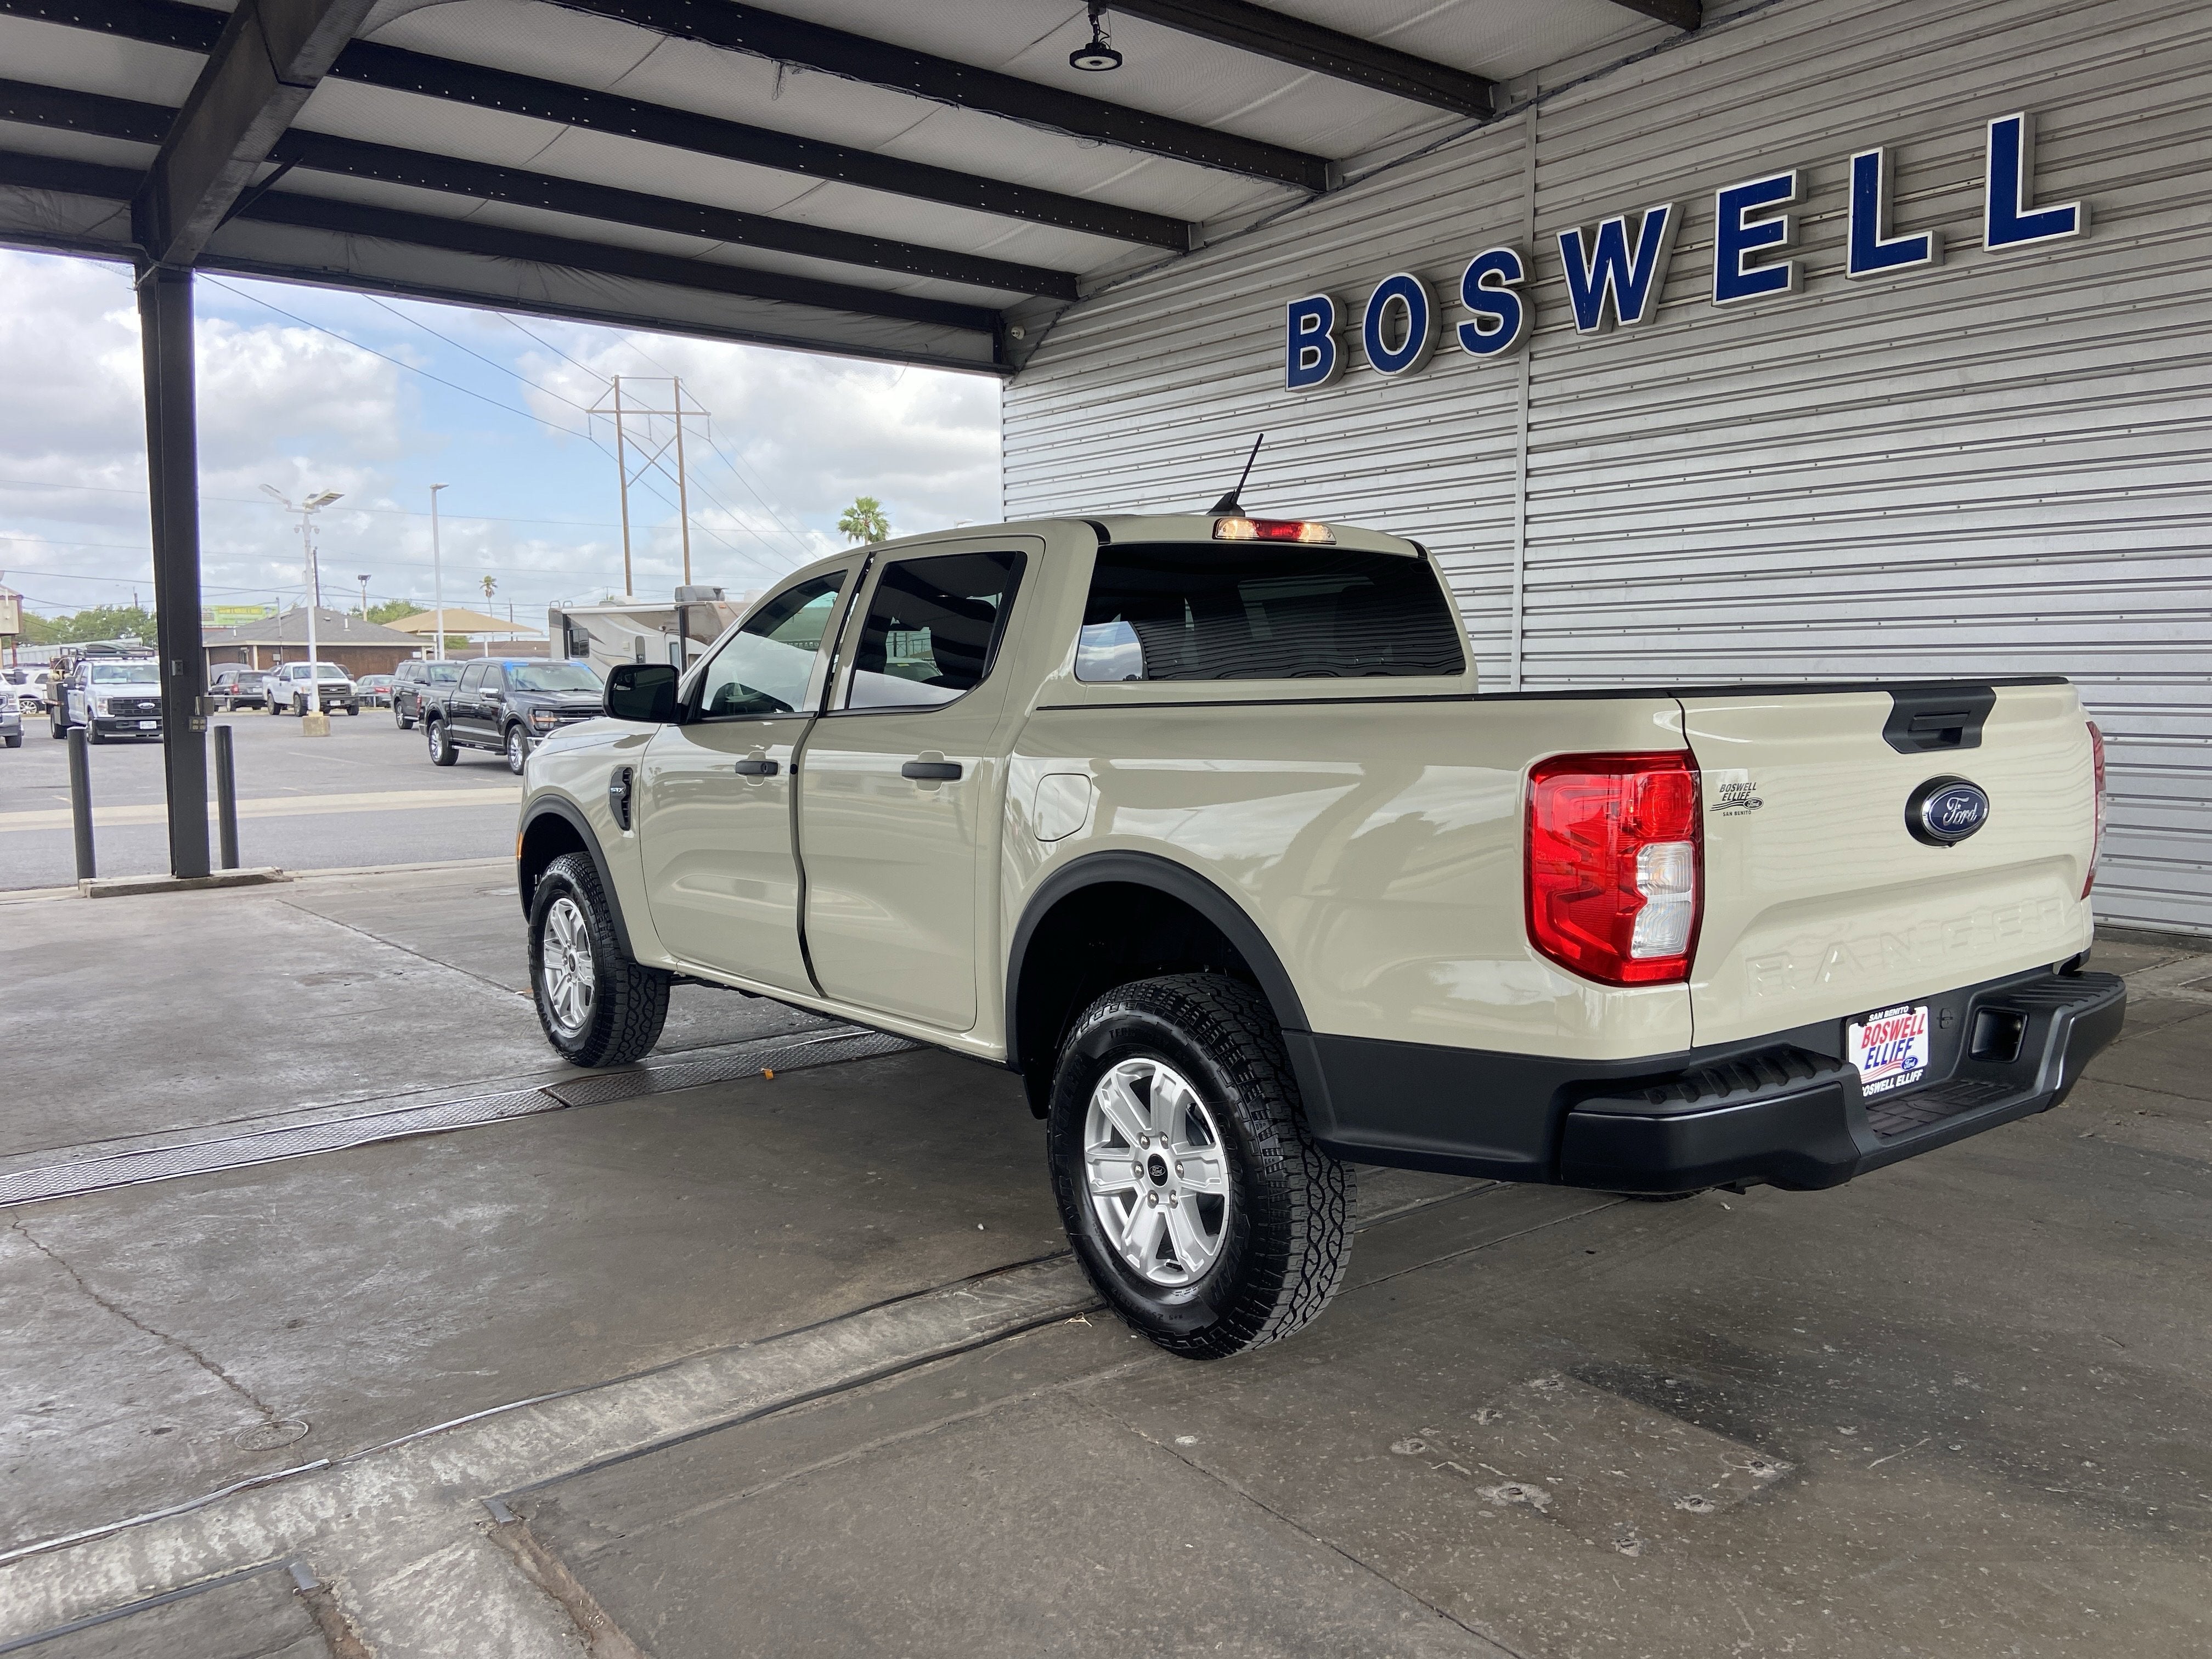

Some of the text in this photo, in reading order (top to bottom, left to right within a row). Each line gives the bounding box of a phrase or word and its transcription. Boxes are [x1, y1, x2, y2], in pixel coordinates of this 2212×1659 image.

[1285, 111, 2082, 392] BOSWELL
[1719, 782, 1757, 793] BOSWELL
[1746, 799, 1760, 808] Ford
[1943, 797, 1978, 826] Ford
[1745, 896, 2068, 997] RANGER
[1868, 1005, 1909, 1022] SAN BENITO
[1860, 1013, 1926, 1049] BOSWELL
[1864, 1036, 1915, 1070] ELLIFF
[1903, 1058, 1917, 1069] Ford
[1862, 1069, 1923, 1097] OSWELL ELLIFF
